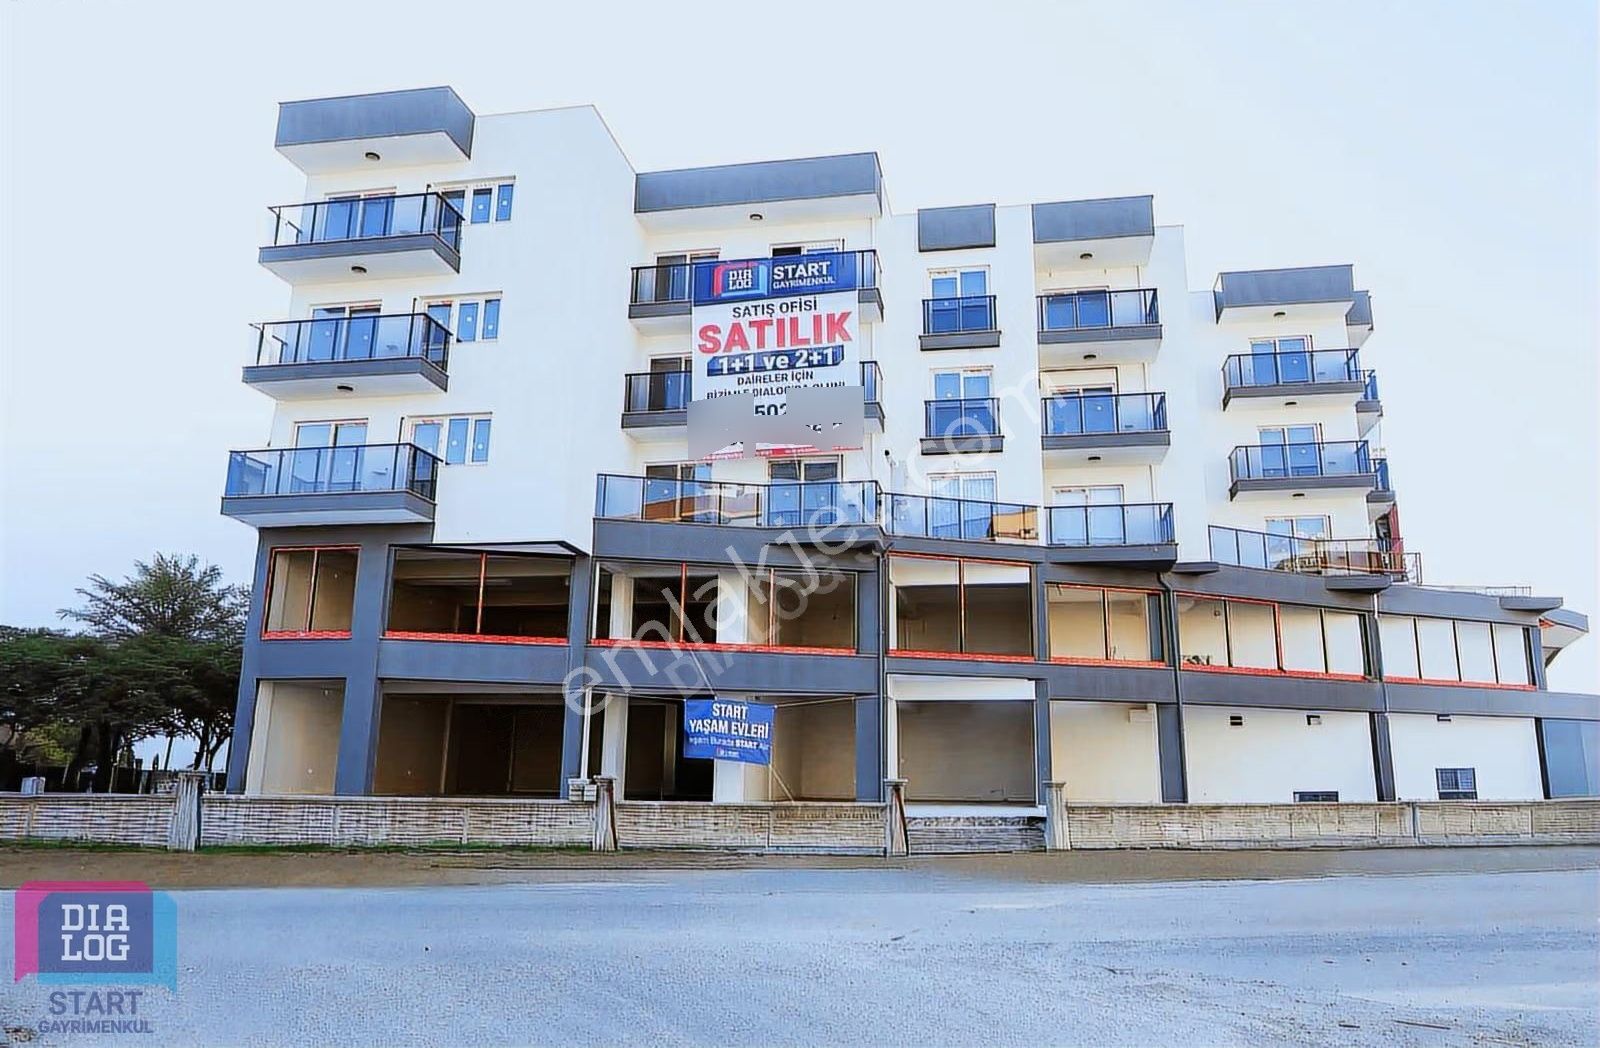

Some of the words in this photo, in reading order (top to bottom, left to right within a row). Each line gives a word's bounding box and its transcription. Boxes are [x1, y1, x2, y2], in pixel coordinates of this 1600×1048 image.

[729, 269, 752, 280] DIA
[773, 261, 830, 280] START
[729, 279, 752, 290] LOG
[732, 303, 775, 319] SATIŞ
[779, 297, 817, 313] OFİSİ
[698, 311, 853, 354] SATILIK
[719, 354, 755, 374] 1+1
[763, 355, 789, 370] ve
[795, 347, 834, 367] 2+1
[737, 374, 788, 386] DAİRELER
[791, 371, 813, 382] İÇİN
[712, 703, 748, 719] START
[689, 719, 728, 735] YAŞAM
[732, 721, 769, 739] EVLERİ
